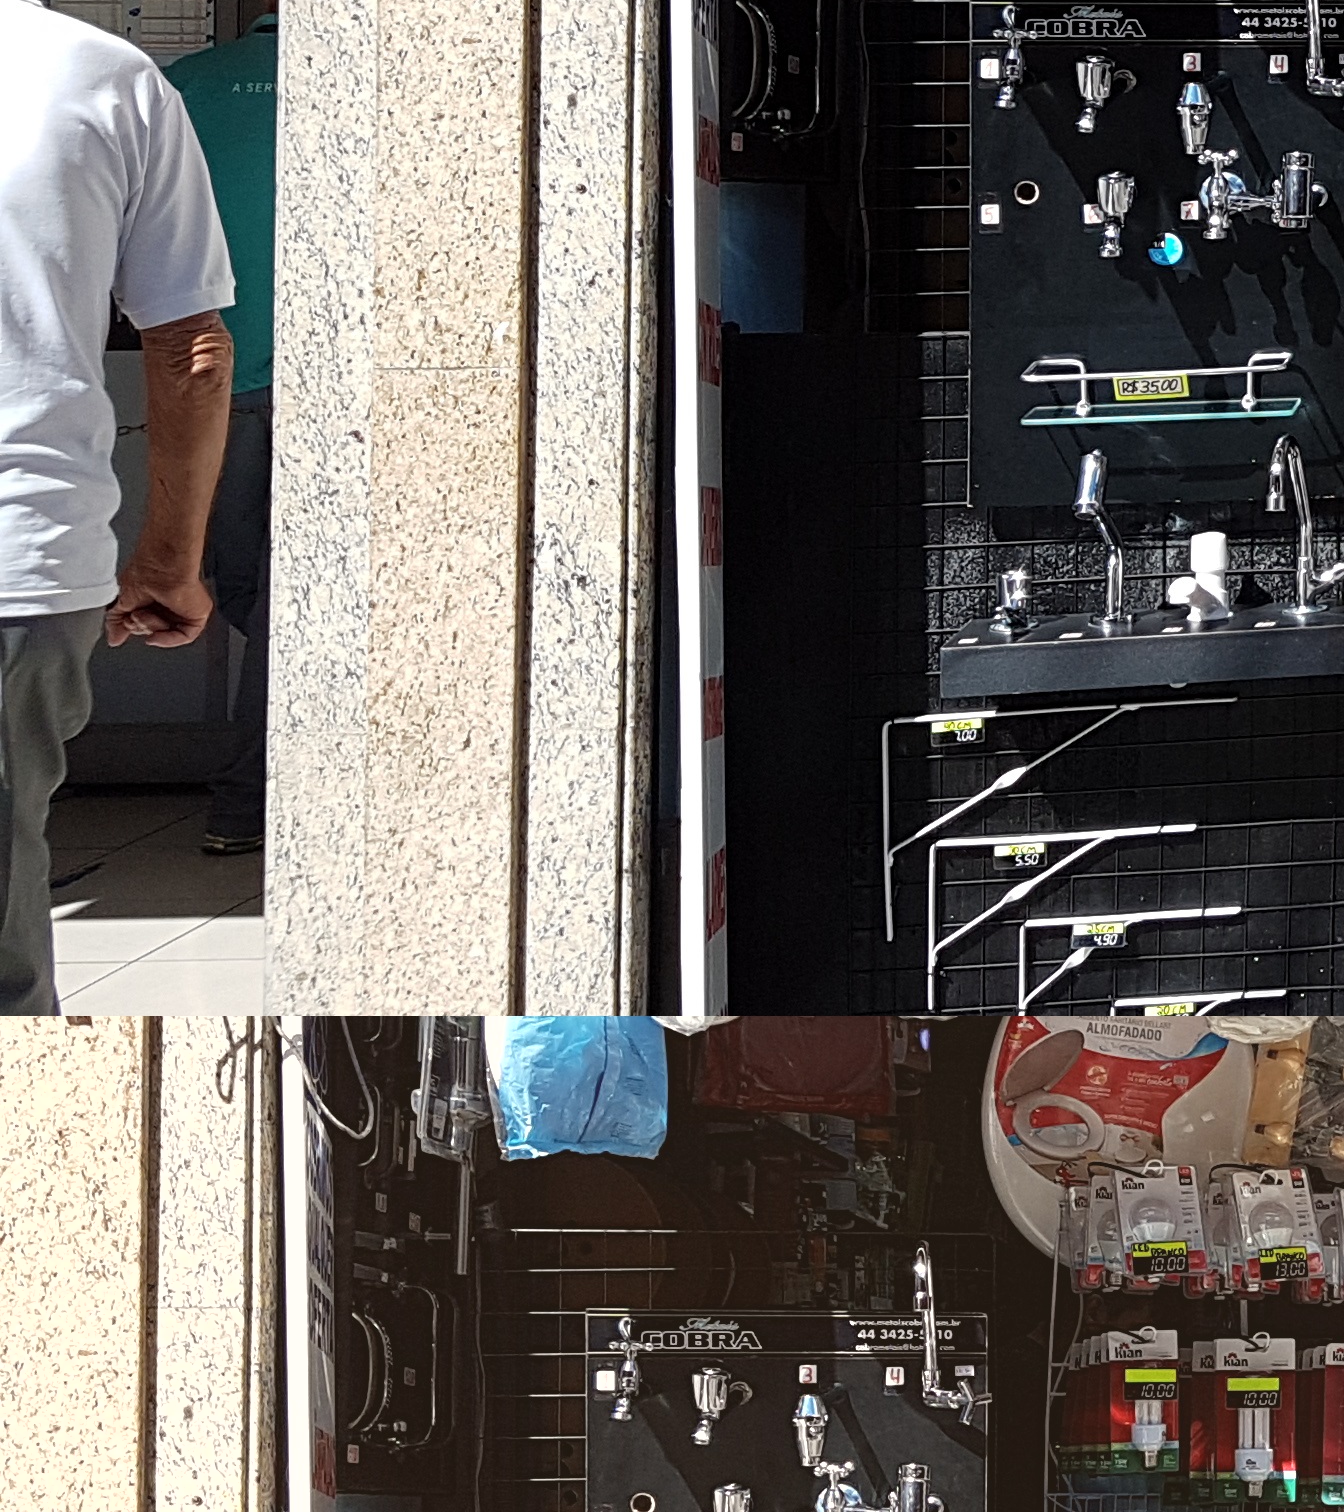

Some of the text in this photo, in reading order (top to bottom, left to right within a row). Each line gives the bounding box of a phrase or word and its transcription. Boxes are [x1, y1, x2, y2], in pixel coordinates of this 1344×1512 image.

[1025, 19, 1146, 38] COBRA
[1241, 16, 1338, 29] 44 3425-510
[1086, 1022, 1163, 1042] ALMOFADADO
[641, 1331, 762, 1350] COBRA
